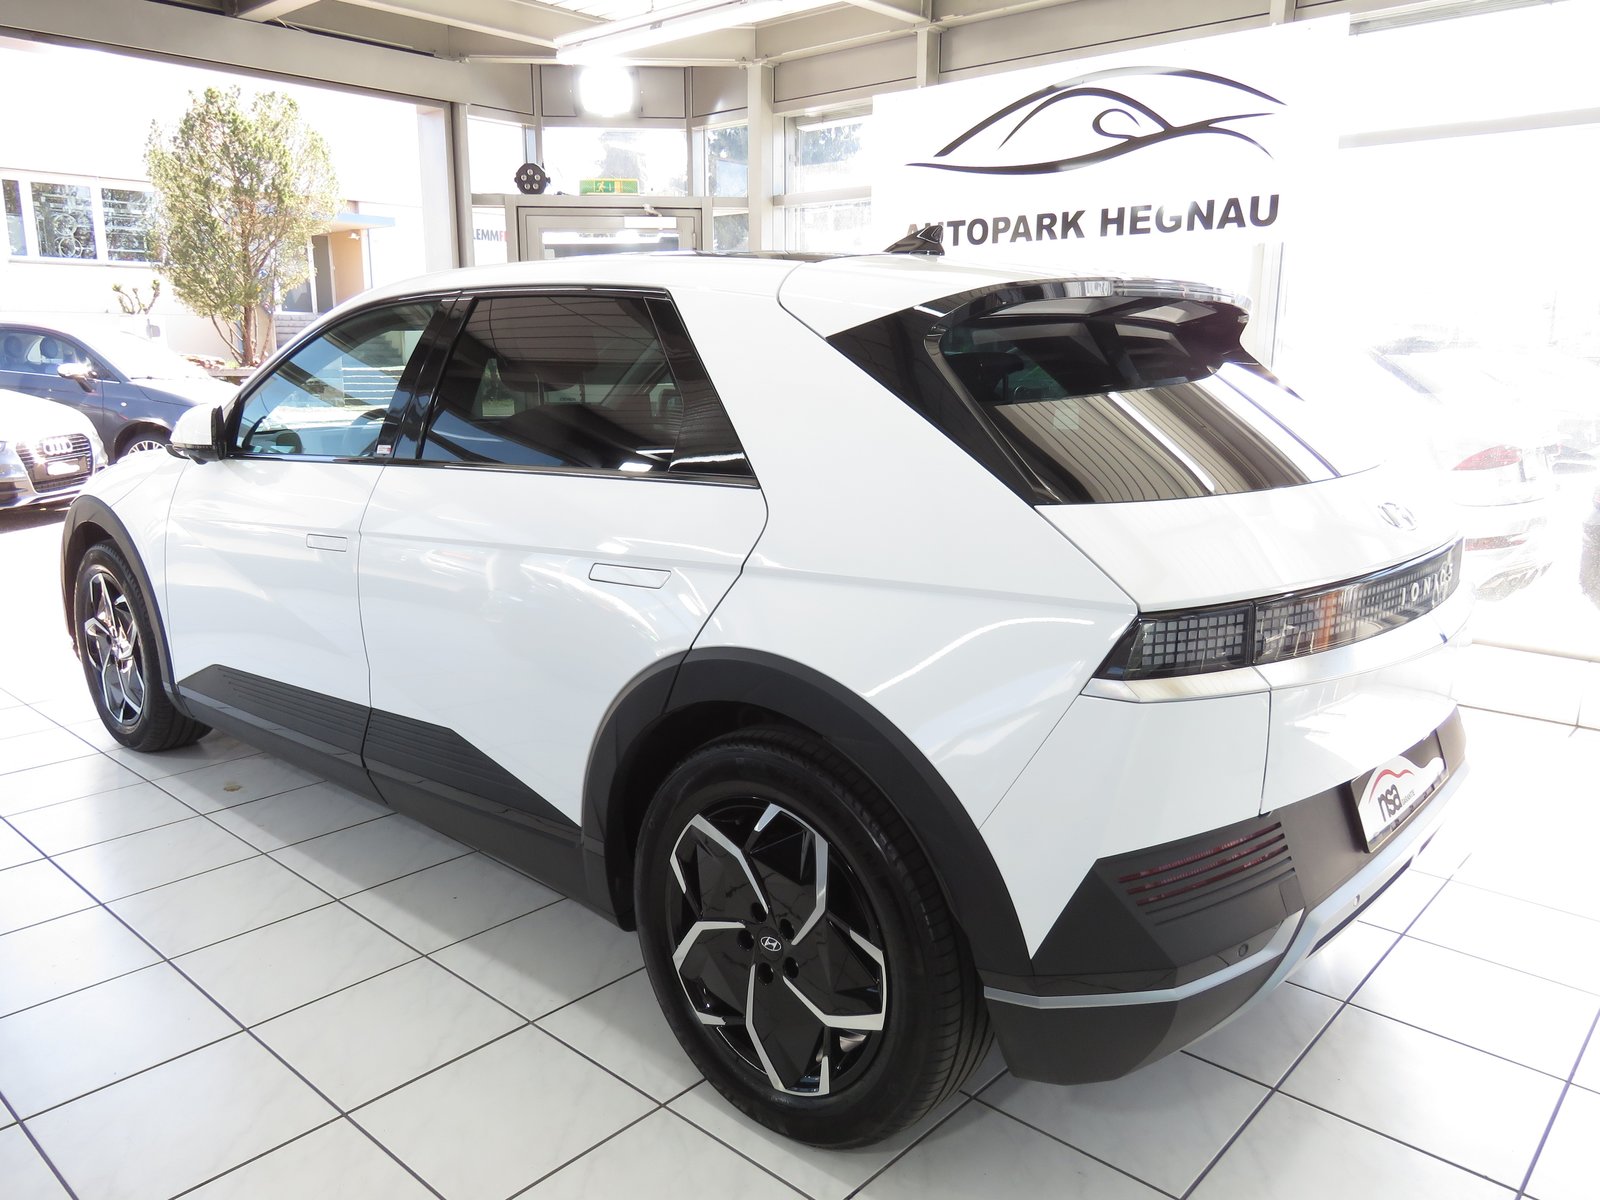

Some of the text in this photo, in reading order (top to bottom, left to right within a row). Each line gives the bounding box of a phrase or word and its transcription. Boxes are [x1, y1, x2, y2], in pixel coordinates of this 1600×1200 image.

[906, 194, 1280, 247] TOPARK HEGNAU
[1377, 784, 1403, 822] nsa
